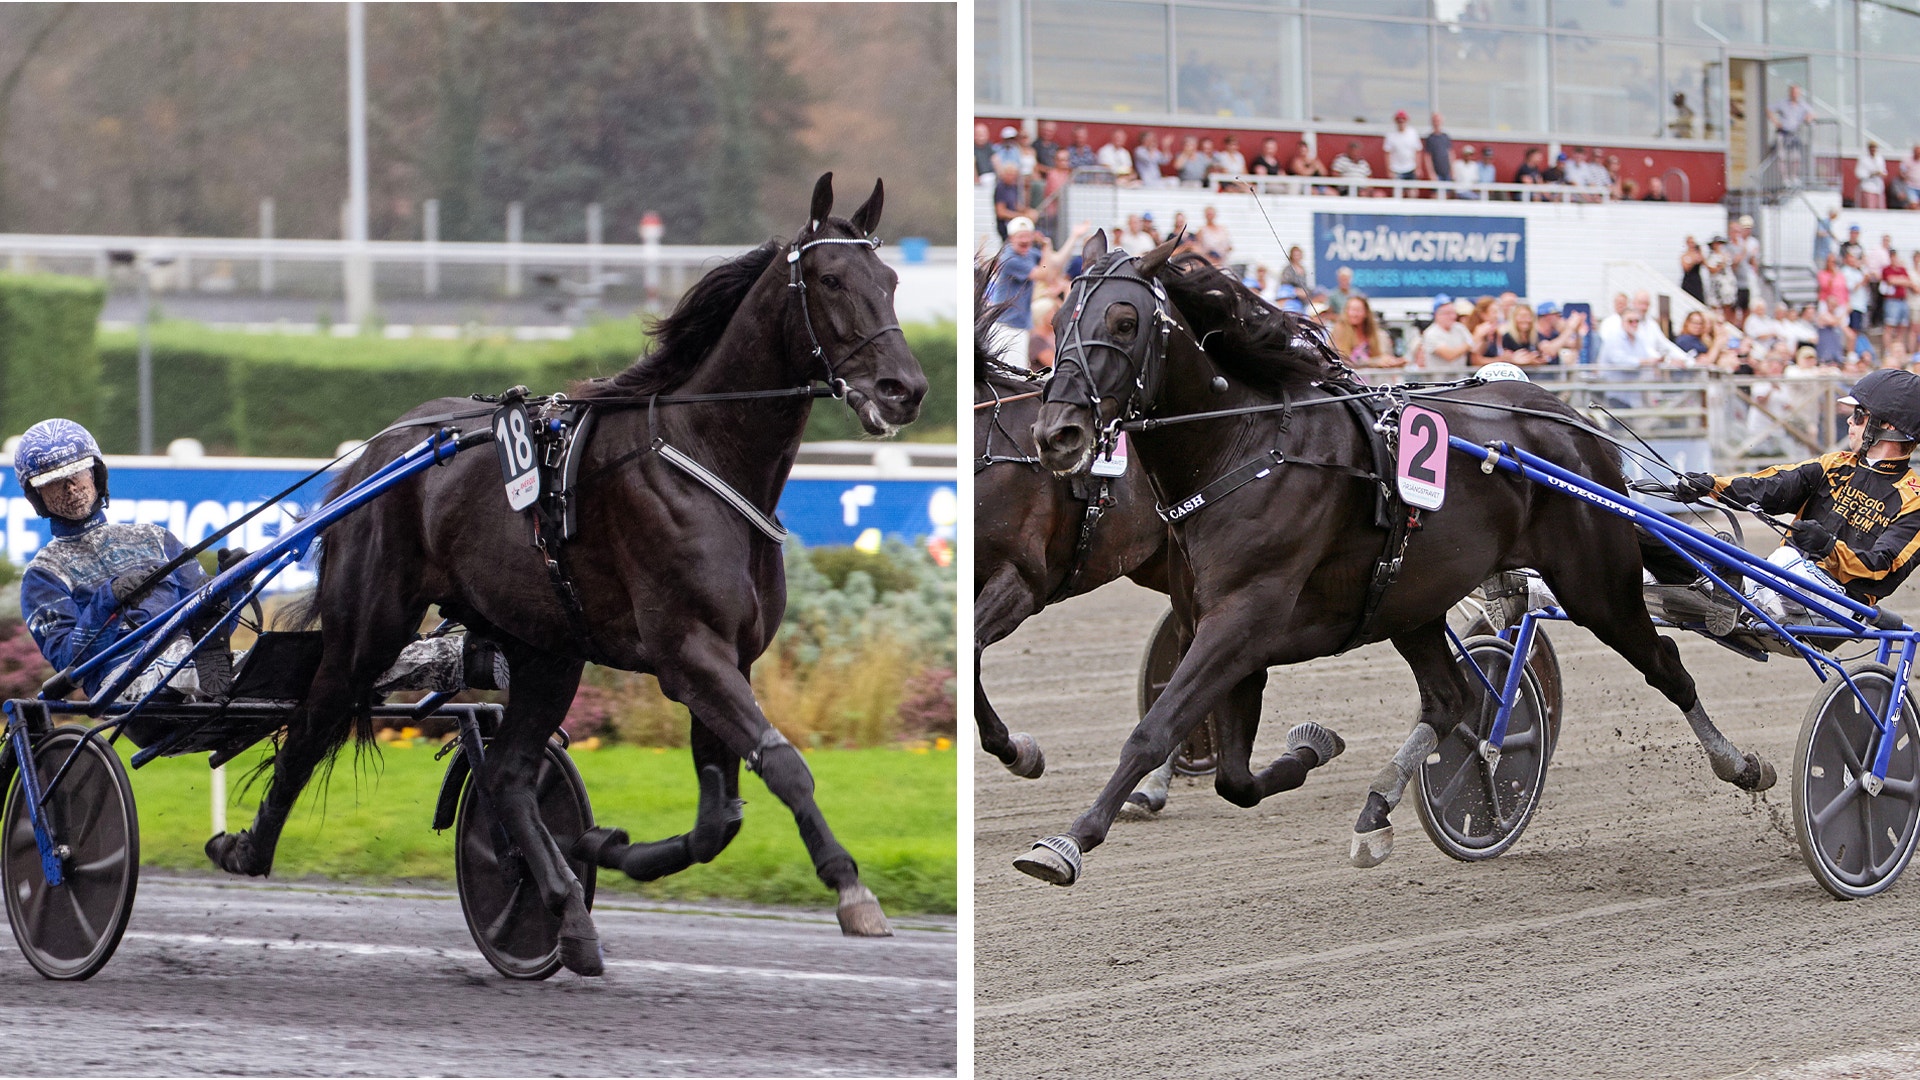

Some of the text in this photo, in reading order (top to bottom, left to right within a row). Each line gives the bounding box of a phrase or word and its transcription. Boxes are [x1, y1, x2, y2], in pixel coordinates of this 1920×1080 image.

[1325, 224, 1521, 263] ÅRJÄNGSTRAVET
[1485, 370, 1516, 379] SVEA
[496, 408, 533, 477] 18
[1408, 413, 1438, 484] 2
[1169, 493, 1206, 520] CASH
[1547, 475, 1637, 518] UFOECLIPSE
[1838, 493, 1890, 528] ECCLING
